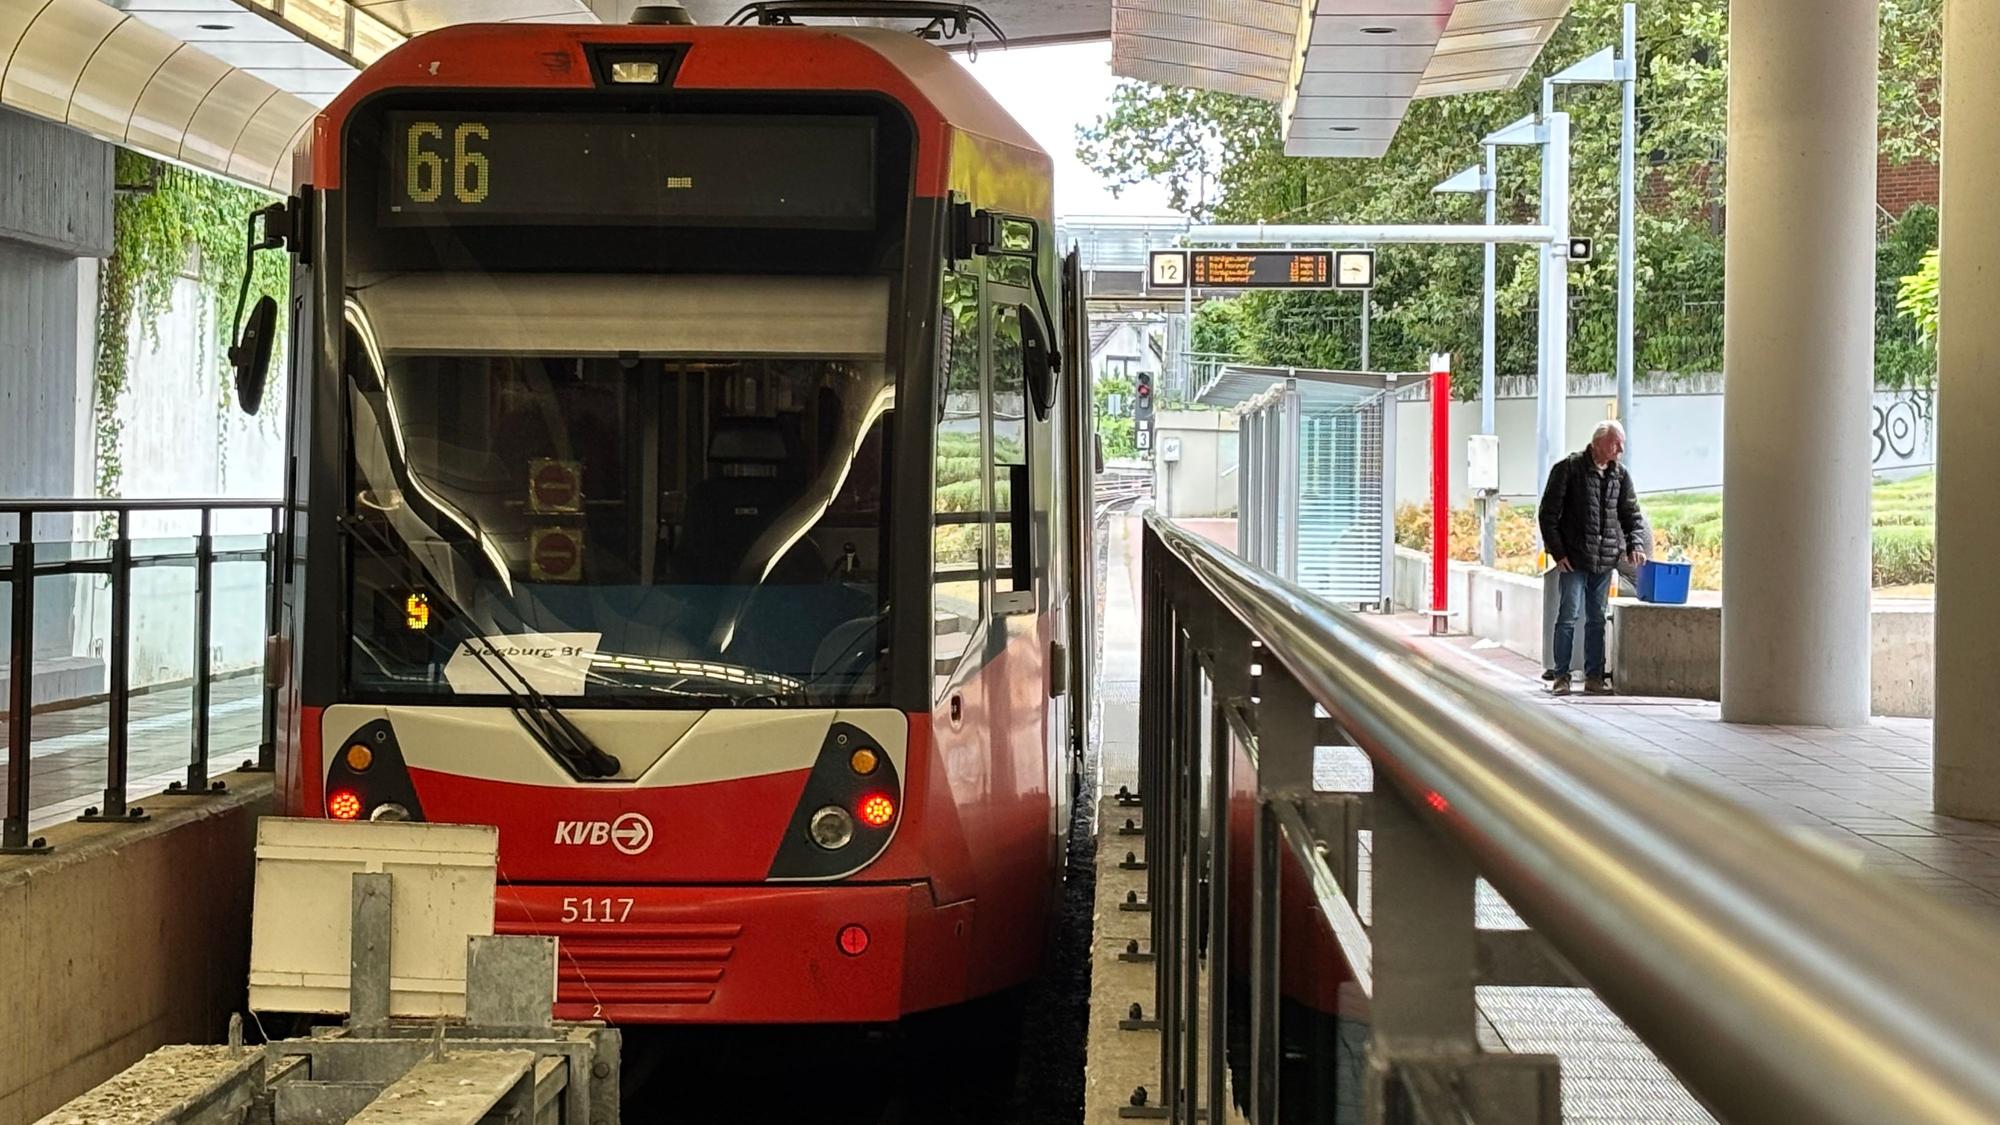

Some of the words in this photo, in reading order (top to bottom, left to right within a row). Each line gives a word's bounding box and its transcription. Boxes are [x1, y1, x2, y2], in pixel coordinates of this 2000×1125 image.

[408, 122, 489, 202] 66
[1160, 264, 1178, 280] 12
[1140, 432, 1147, 446] 3
[553, 821, 611, 846] KVB
[561, 897, 635, 923] 5117
[592, 1004, 602, 1018] 2
